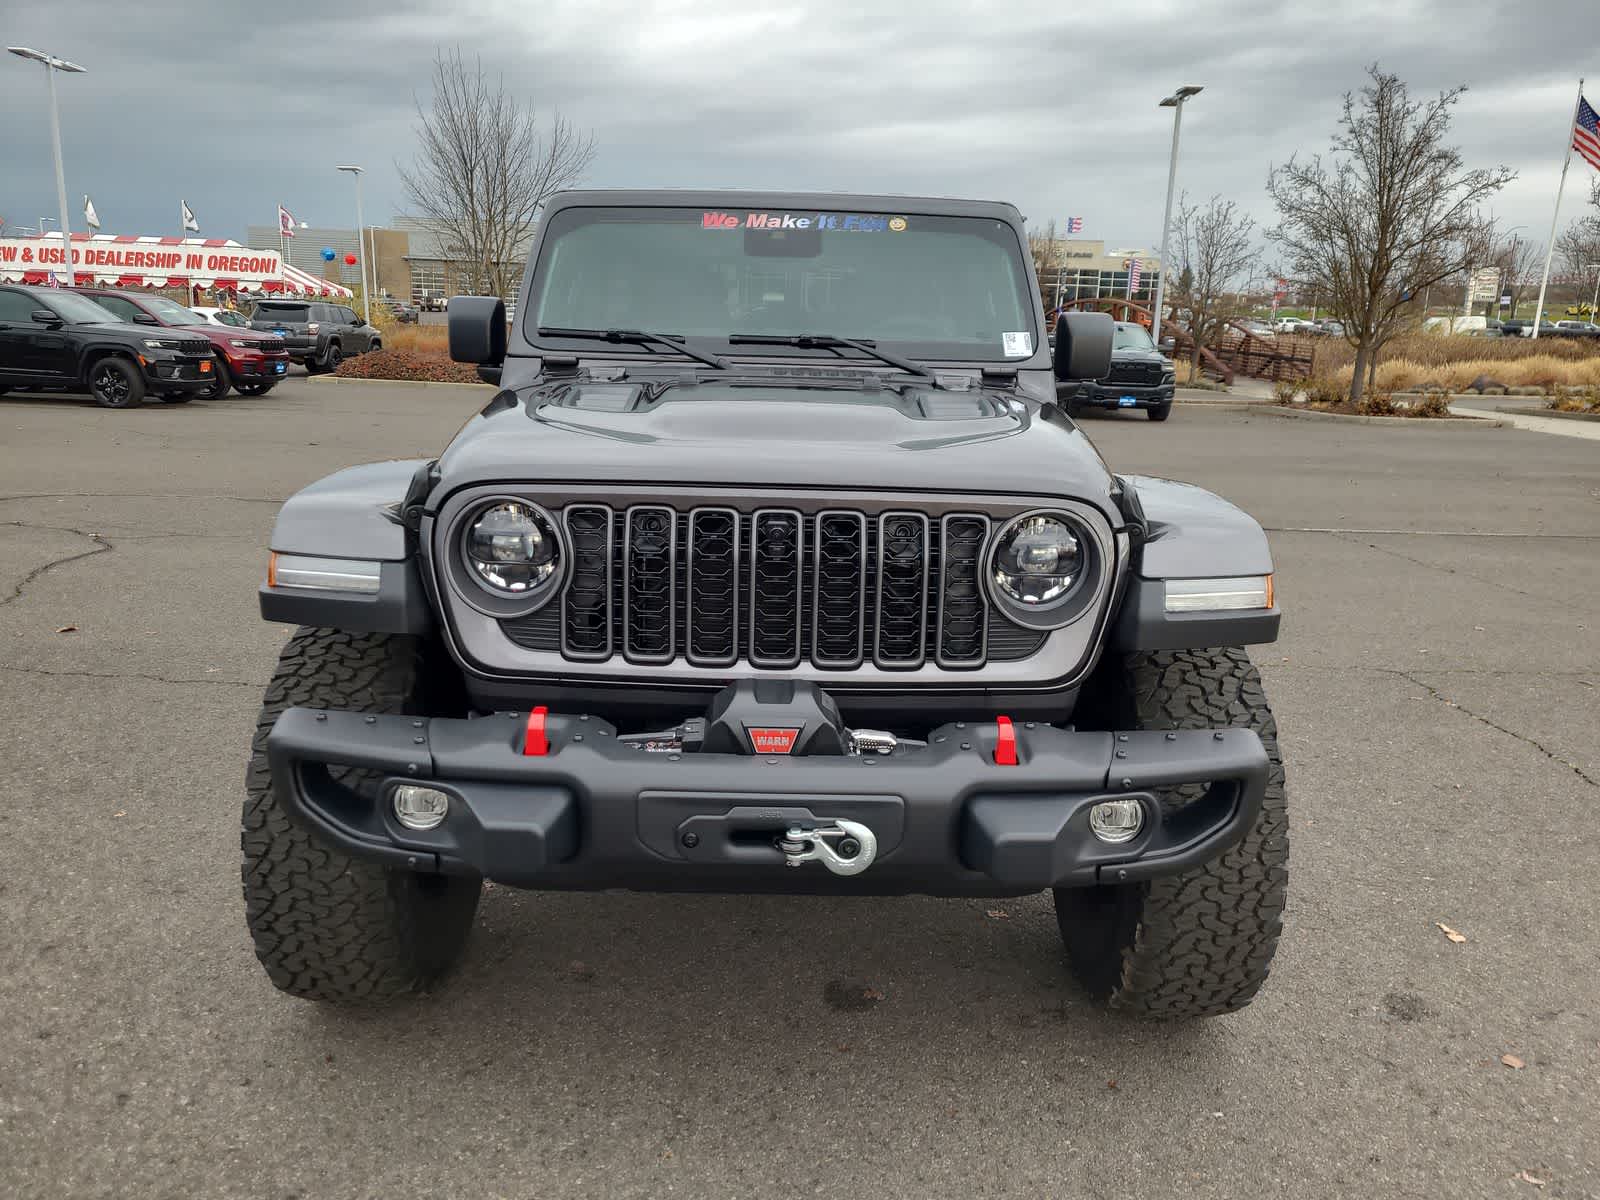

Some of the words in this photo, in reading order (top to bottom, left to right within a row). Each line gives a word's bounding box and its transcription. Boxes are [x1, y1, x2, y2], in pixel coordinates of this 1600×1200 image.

[703, 212, 739, 229] We
[746, 213, 810, 229] Make
[816, 215, 837, 229] It
[0, 246, 17, 262] W
[21, 247, 33, 262] &
[85, 249, 181, 269] DEALERSHIP
[186, 254, 203, 270] IN
[208, 255, 277, 274] OREGON!
[757, 735, 790, 746] WARN
